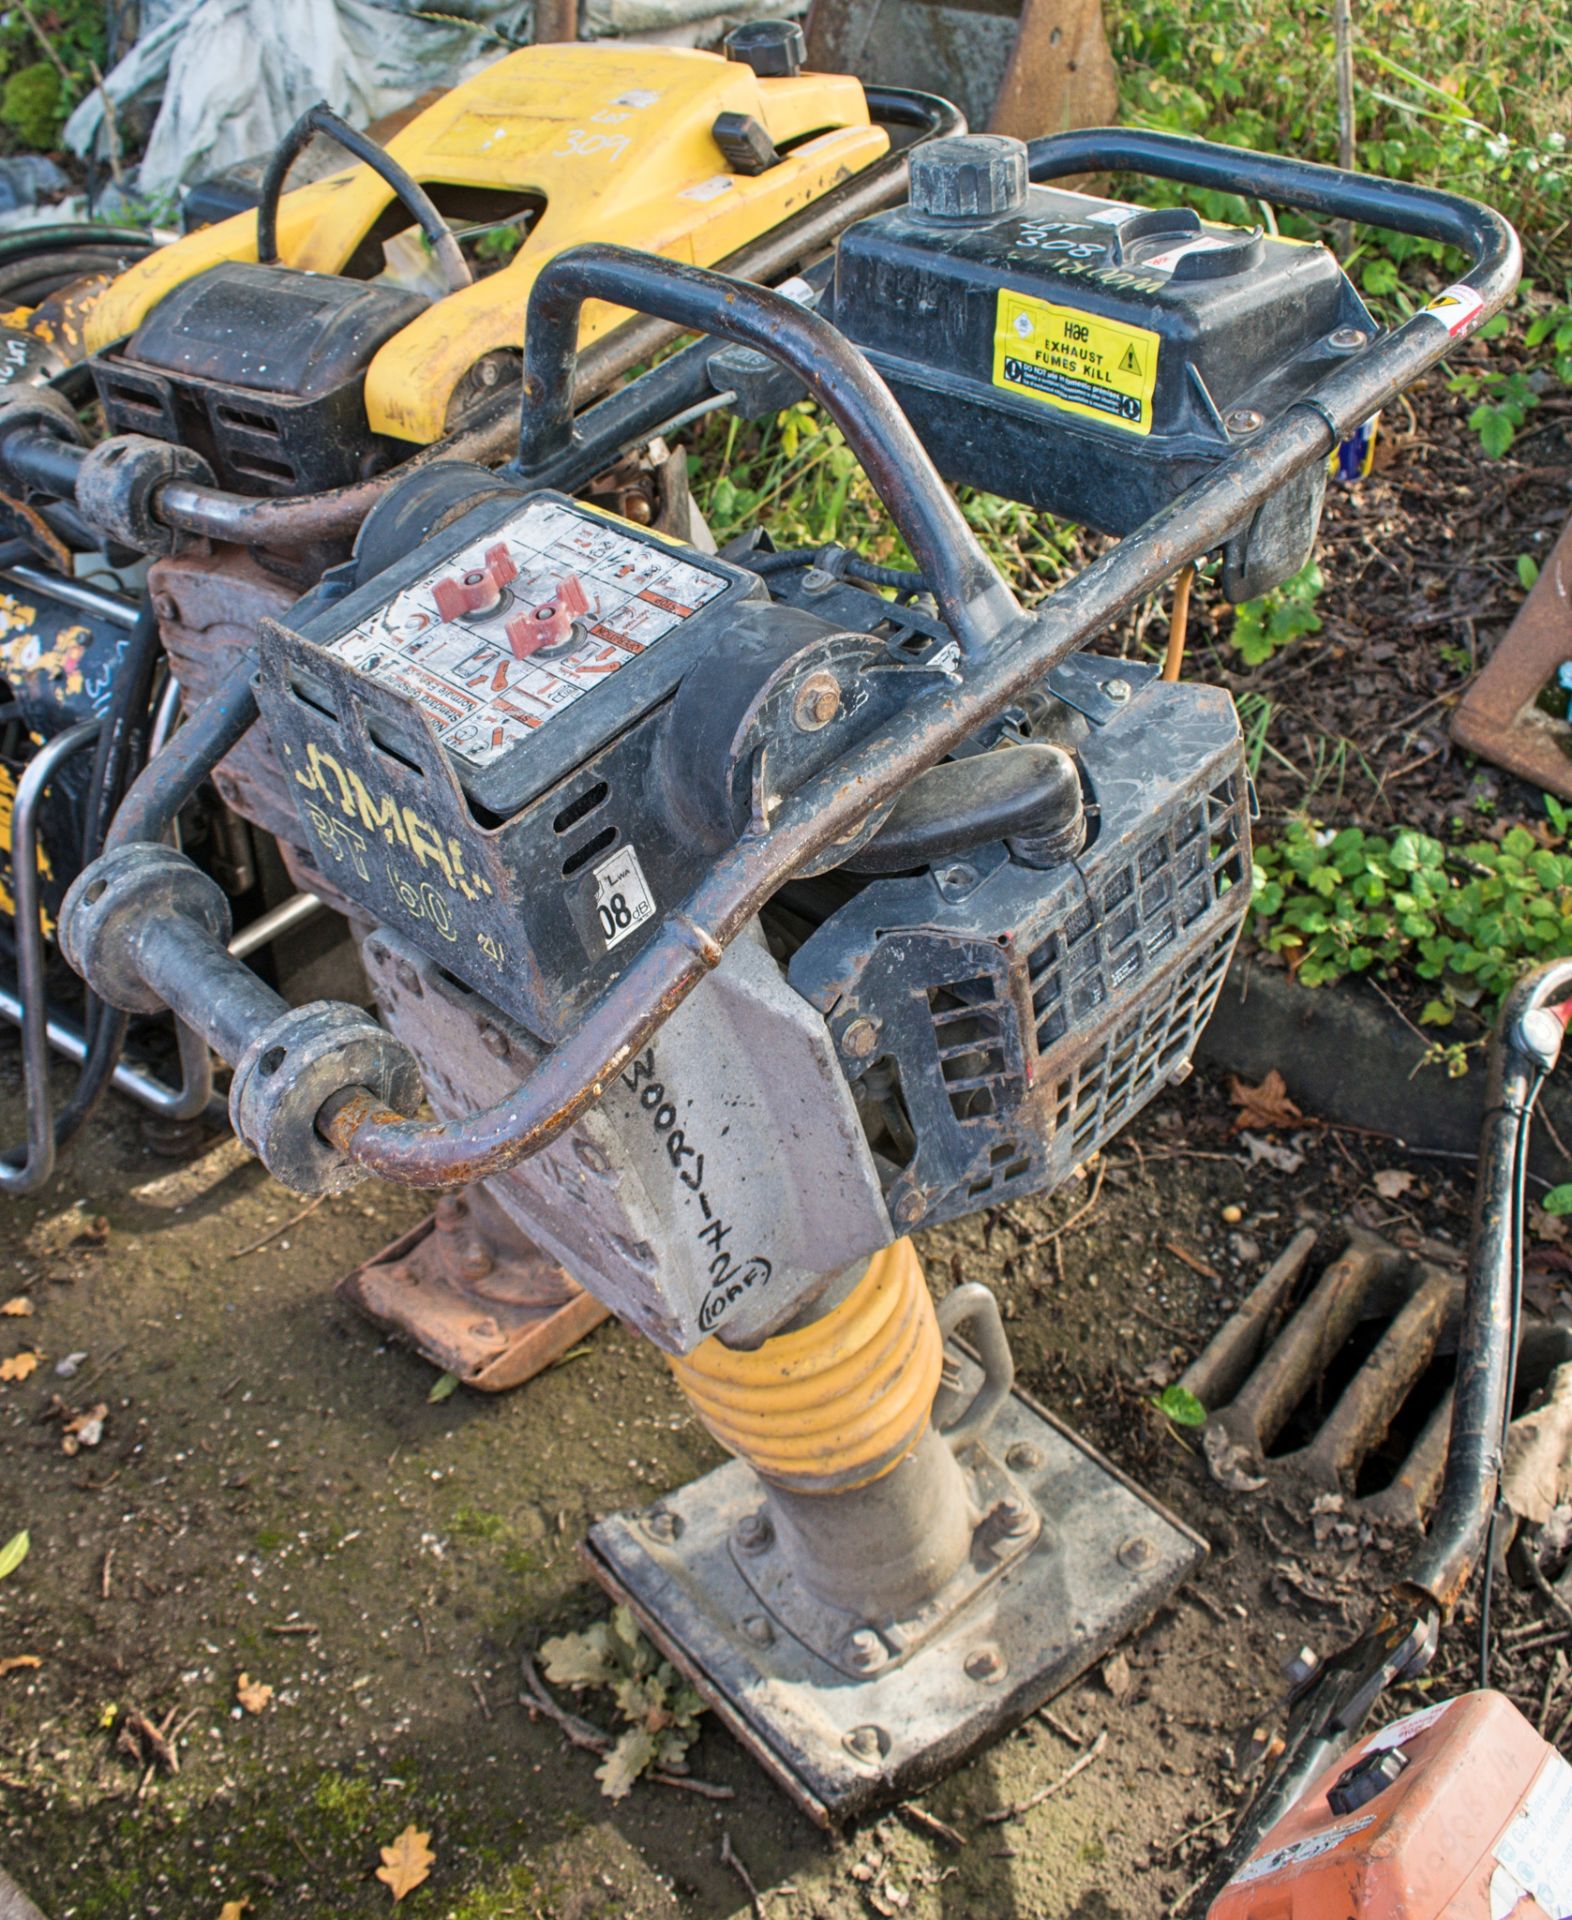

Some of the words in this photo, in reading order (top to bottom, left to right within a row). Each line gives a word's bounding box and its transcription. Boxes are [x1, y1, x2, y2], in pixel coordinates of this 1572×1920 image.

[552, 128, 631, 163] 309
[1015, 229, 1106, 259] 308
[1035, 351, 1077, 372] FUMES
[1083, 365, 1112, 383] KILL
[1045, 339, 1103, 366] EXHAUST
[420, 691, 461, 722] Standard
